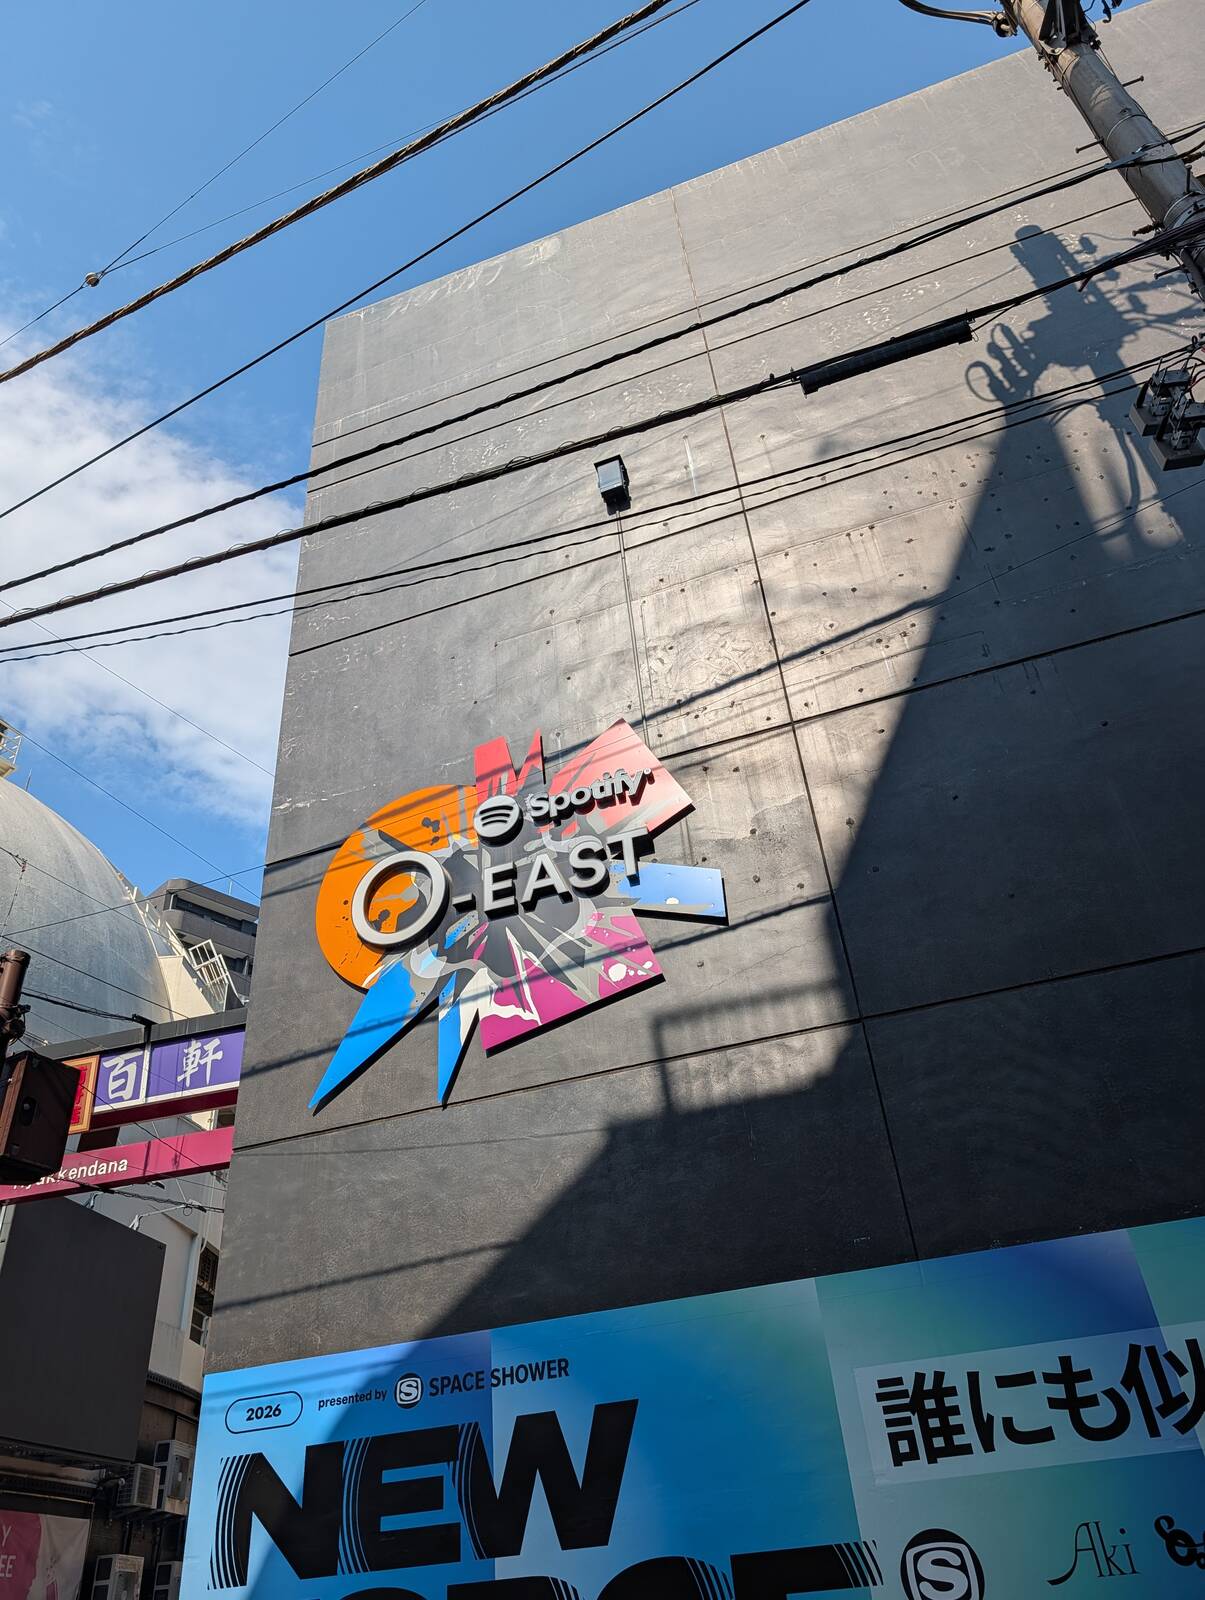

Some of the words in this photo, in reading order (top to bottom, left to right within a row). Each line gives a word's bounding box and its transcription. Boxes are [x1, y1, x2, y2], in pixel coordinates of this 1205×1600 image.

[351, 827, 650, 947] O-EAST
[245, 1403, 283, 1422] 2026
[317, 1392, 371, 1411] presented
[374, 1389, 388, 1403] by
[428, 1370, 486, 1397] SPACE
[490, 1358, 570, 1387] SHOWER
[875, 1338, 1205, 1468] 誰にも似
[207, 1398, 639, 1591] NEW
[1047, 1520, 1142, 1586] Aki
